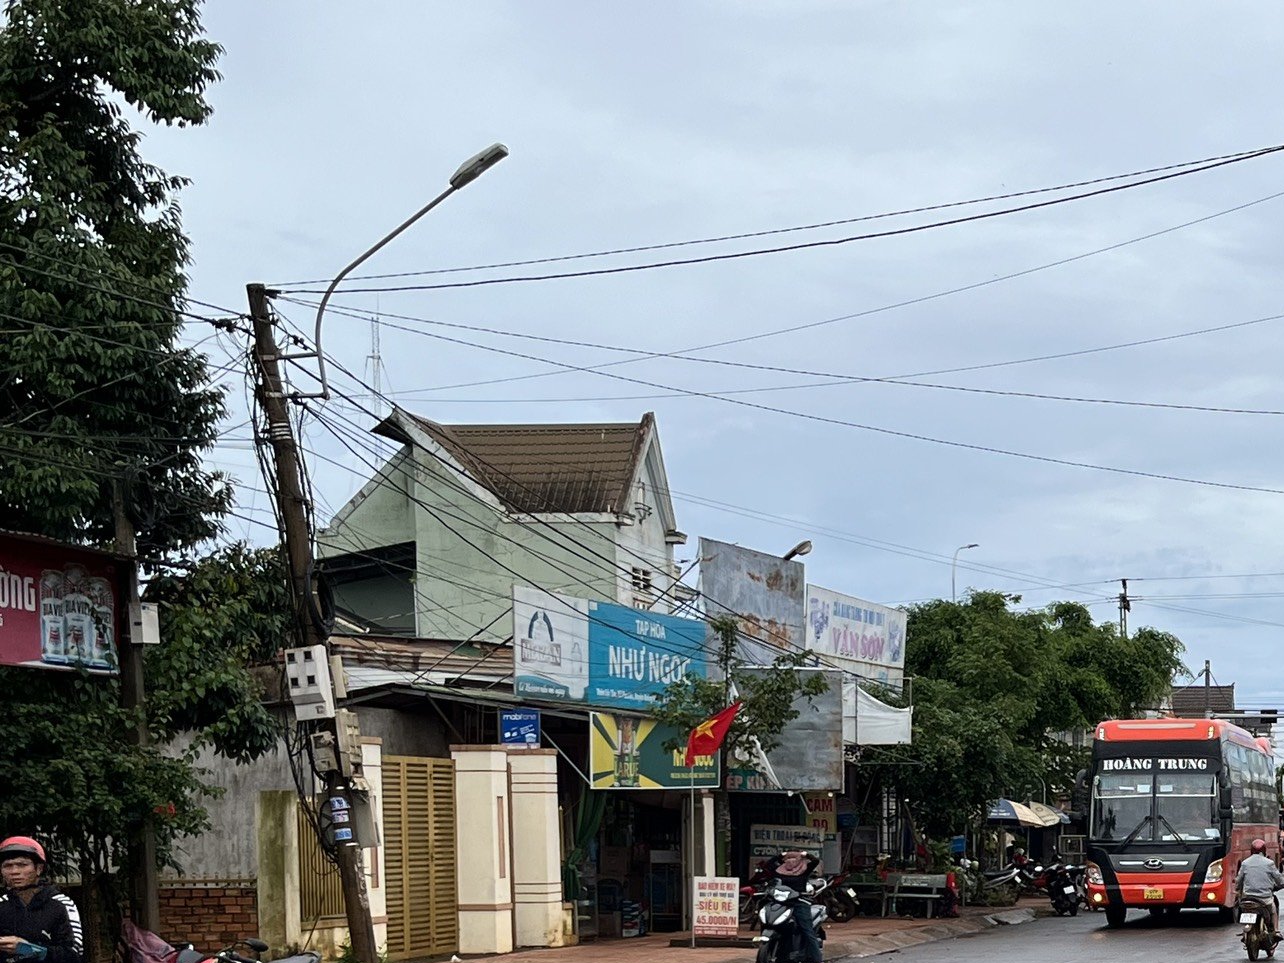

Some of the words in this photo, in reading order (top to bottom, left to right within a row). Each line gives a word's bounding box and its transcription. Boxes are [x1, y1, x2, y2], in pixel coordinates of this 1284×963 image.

[609, 644, 646, 681] NHƯ
[1102, 757, 1152, 771] HOÀNG
[1158, 758, 1208, 770] TRUNG
[699, 899, 719, 911] SIÊU
